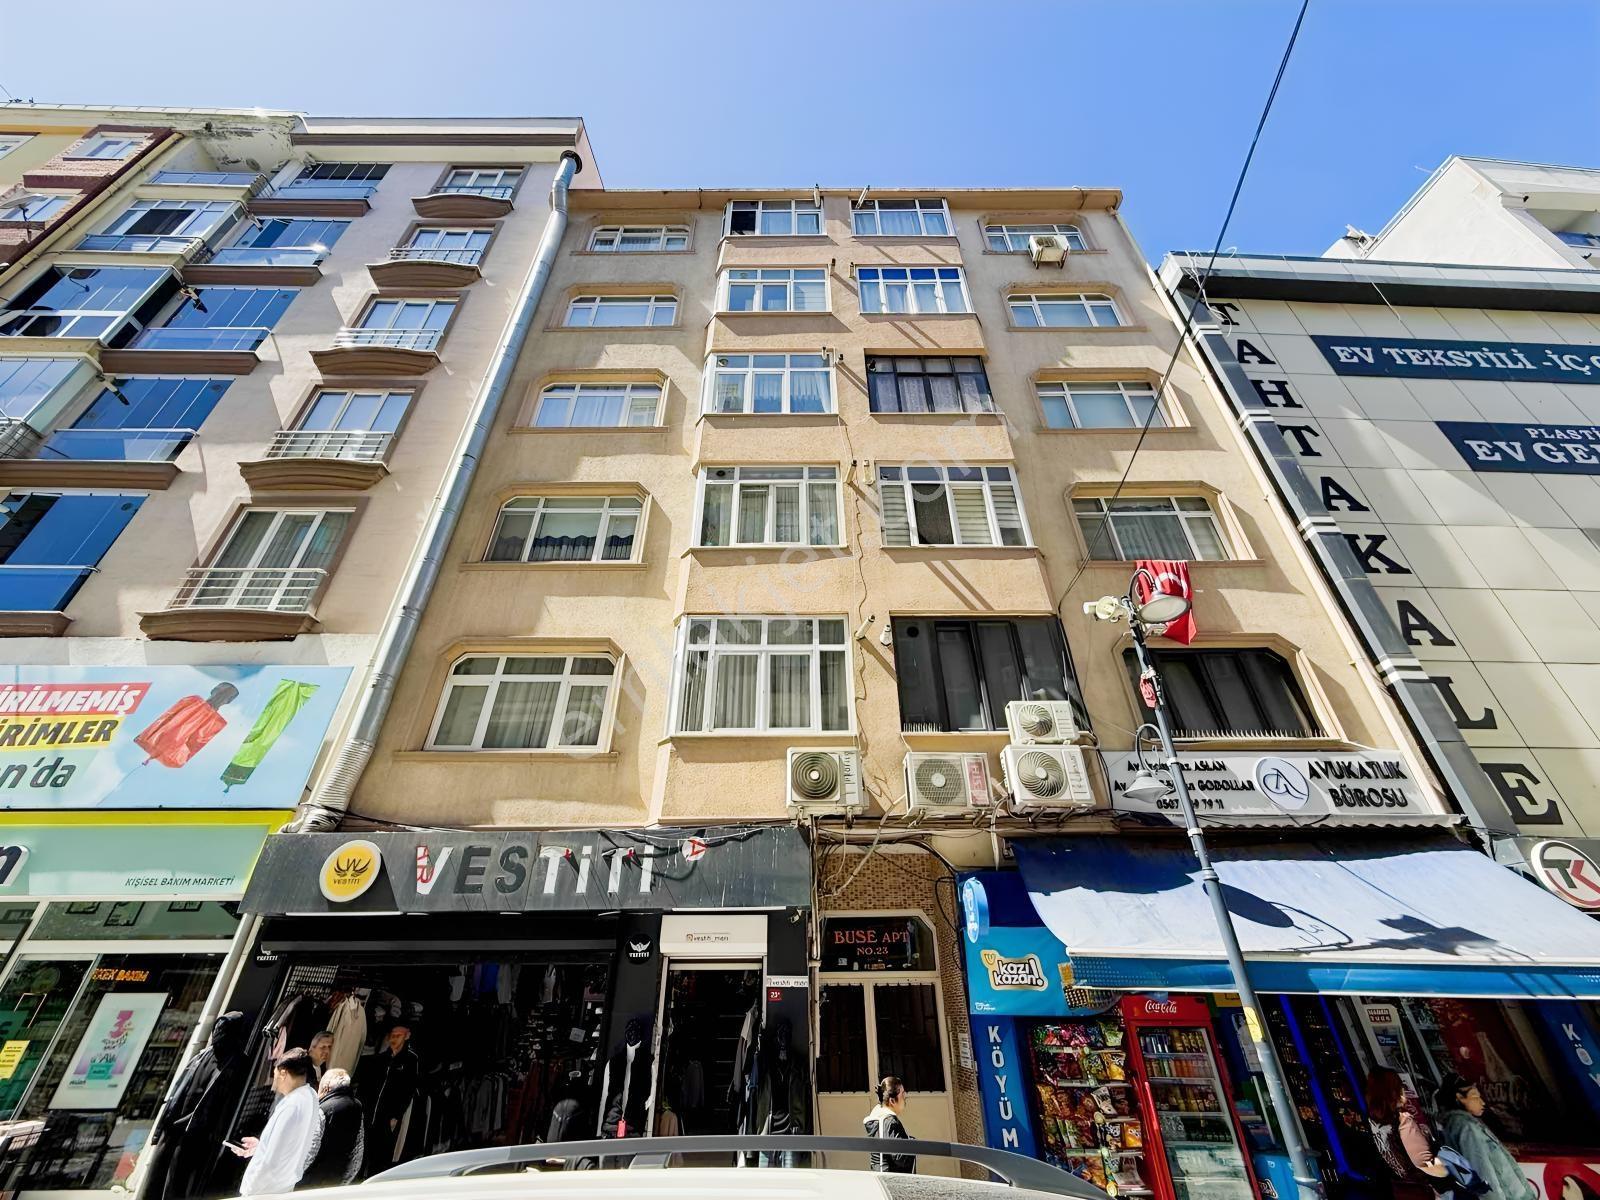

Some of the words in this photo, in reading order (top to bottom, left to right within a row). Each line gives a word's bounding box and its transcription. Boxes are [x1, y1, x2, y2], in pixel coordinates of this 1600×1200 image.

[1330, 346, 1374, 364] EV
[1381, 347, 1537, 370] TEKSTİLİ
[1463, 440, 1526, 462] EV
[1532, 442, 1600, 464] GE
[1208, 302, 1563, 825] TAHTAKALE
[1308, 761, 1408, 780] AVUKATLIK
[1328, 784, 1409, 808] BÜROSU
[161, 877, 191, 887] BAKIM
[192, 874, 236, 887] MARKETİ
[834, 930, 878, 944] BUSE
[987, 1025, 1020, 1148] KÖYÜM
